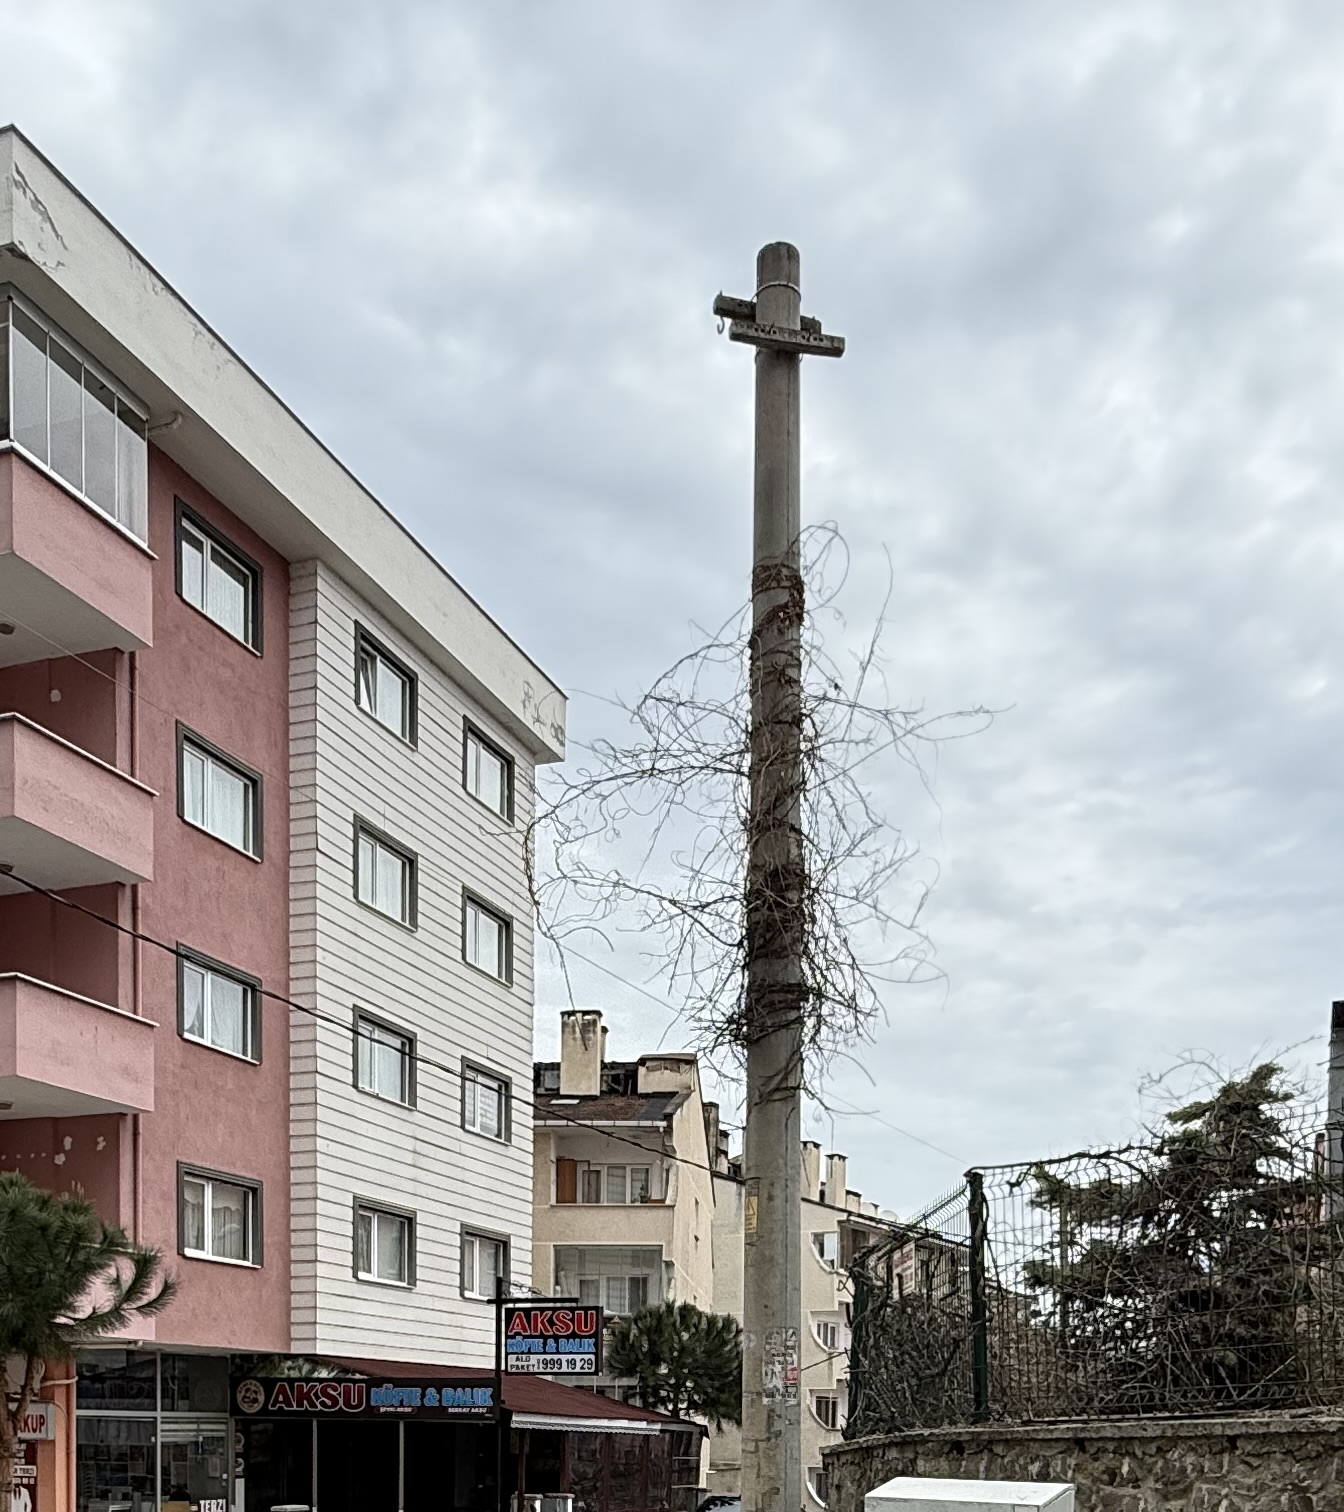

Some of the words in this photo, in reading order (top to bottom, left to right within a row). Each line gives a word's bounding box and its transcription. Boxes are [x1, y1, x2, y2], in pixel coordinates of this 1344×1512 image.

[507, 1310, 596, 1335] AKSU
[506, 1335, 544, 1353] KÖFTE
[545, 1338, 557, 1353] &
[558, 1338, 596, 1353] BALIK
[541, 1358, 563, 1371] 999
[579, 1358, 594, 1370] 29
[268, 1382, 366, 1412] AKSU
[370, 1383, 422, 1407] KÖFTE
[424, 1387, 440, 1407] &
[441, 1387, 494, 1407] BALIK
